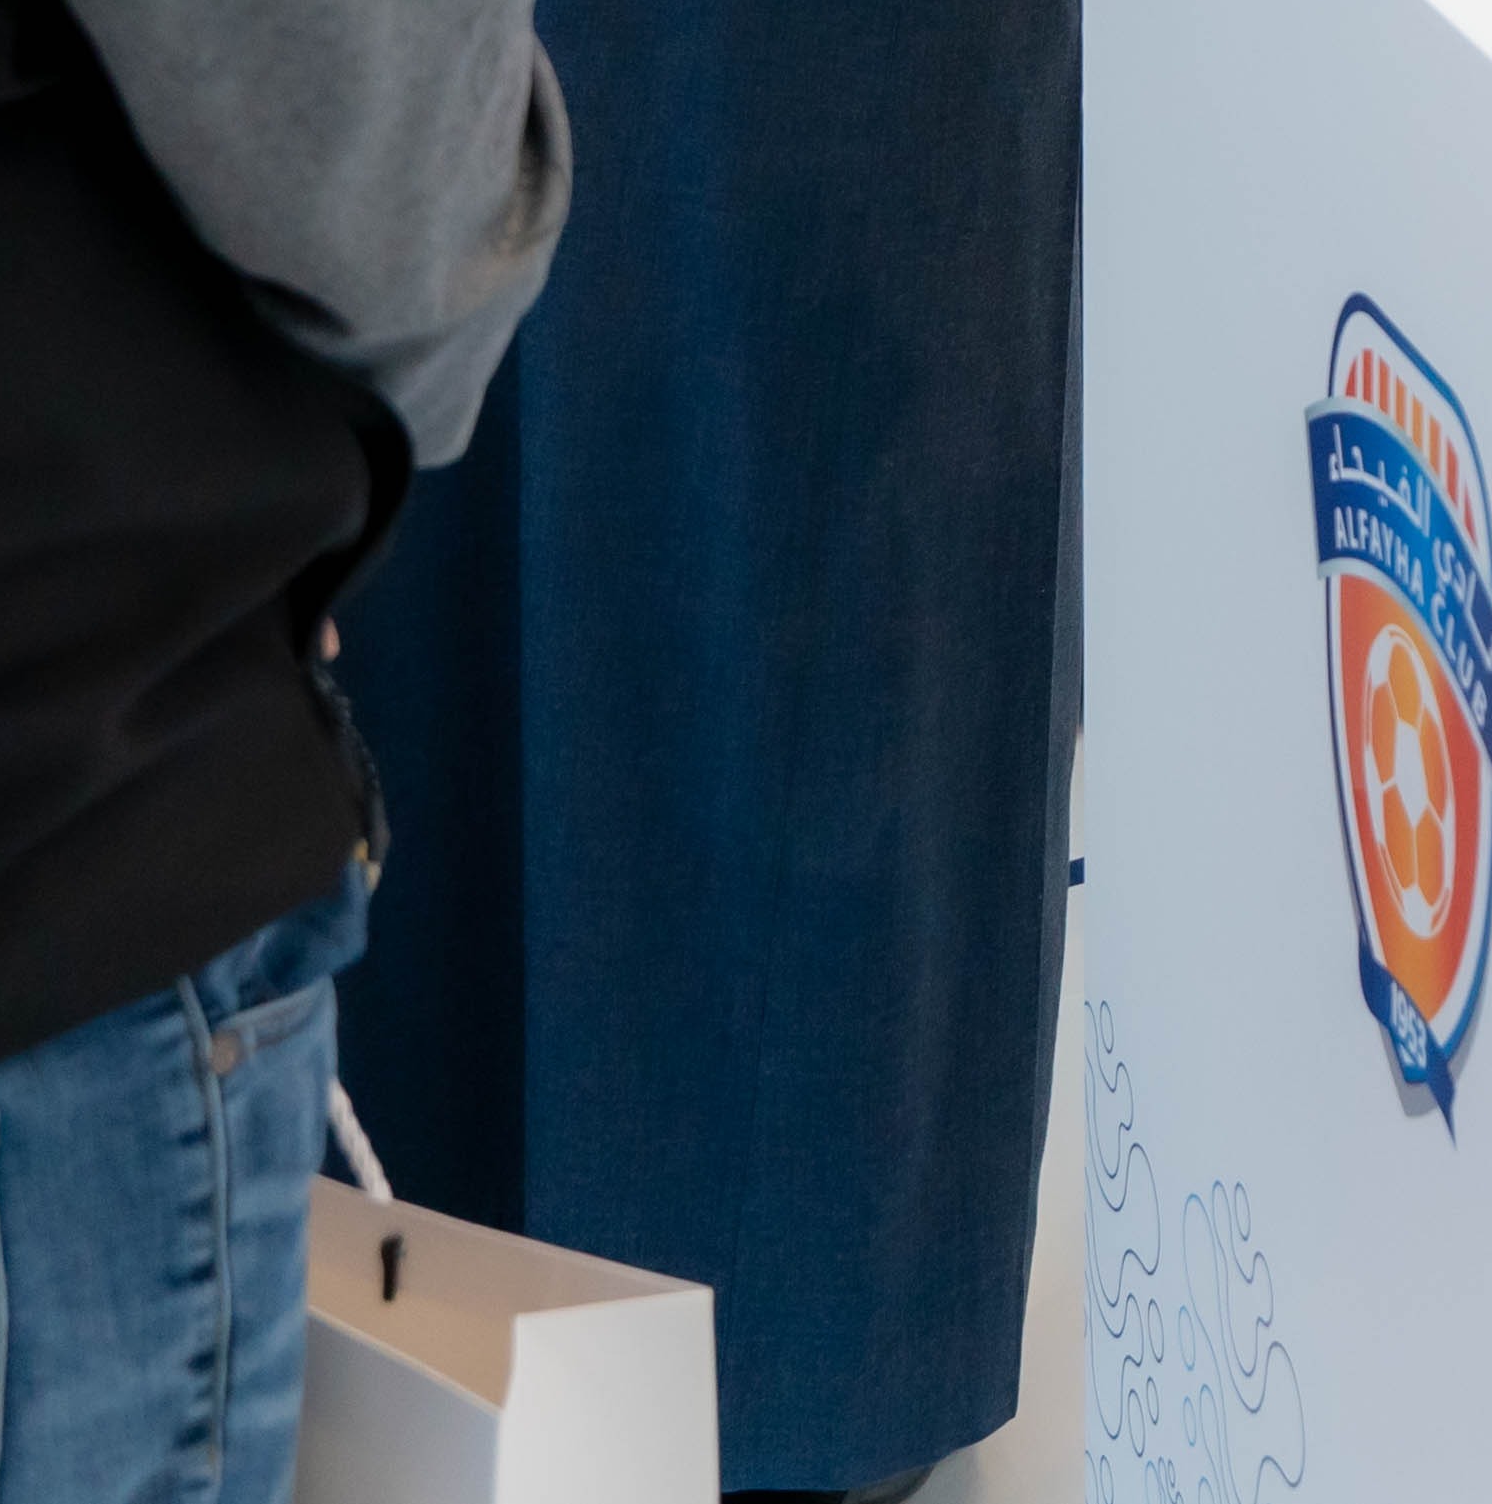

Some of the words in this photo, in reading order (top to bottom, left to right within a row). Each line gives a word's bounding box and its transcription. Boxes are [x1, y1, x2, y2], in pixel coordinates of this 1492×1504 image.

[1328, 421, 1433, 538] الفيحاء
[1333, 505, 1426, 607] ALFAYHA
[1430, 591, 1489, 730] CLUB
[1388, 980, 1429, 1069] 1953
